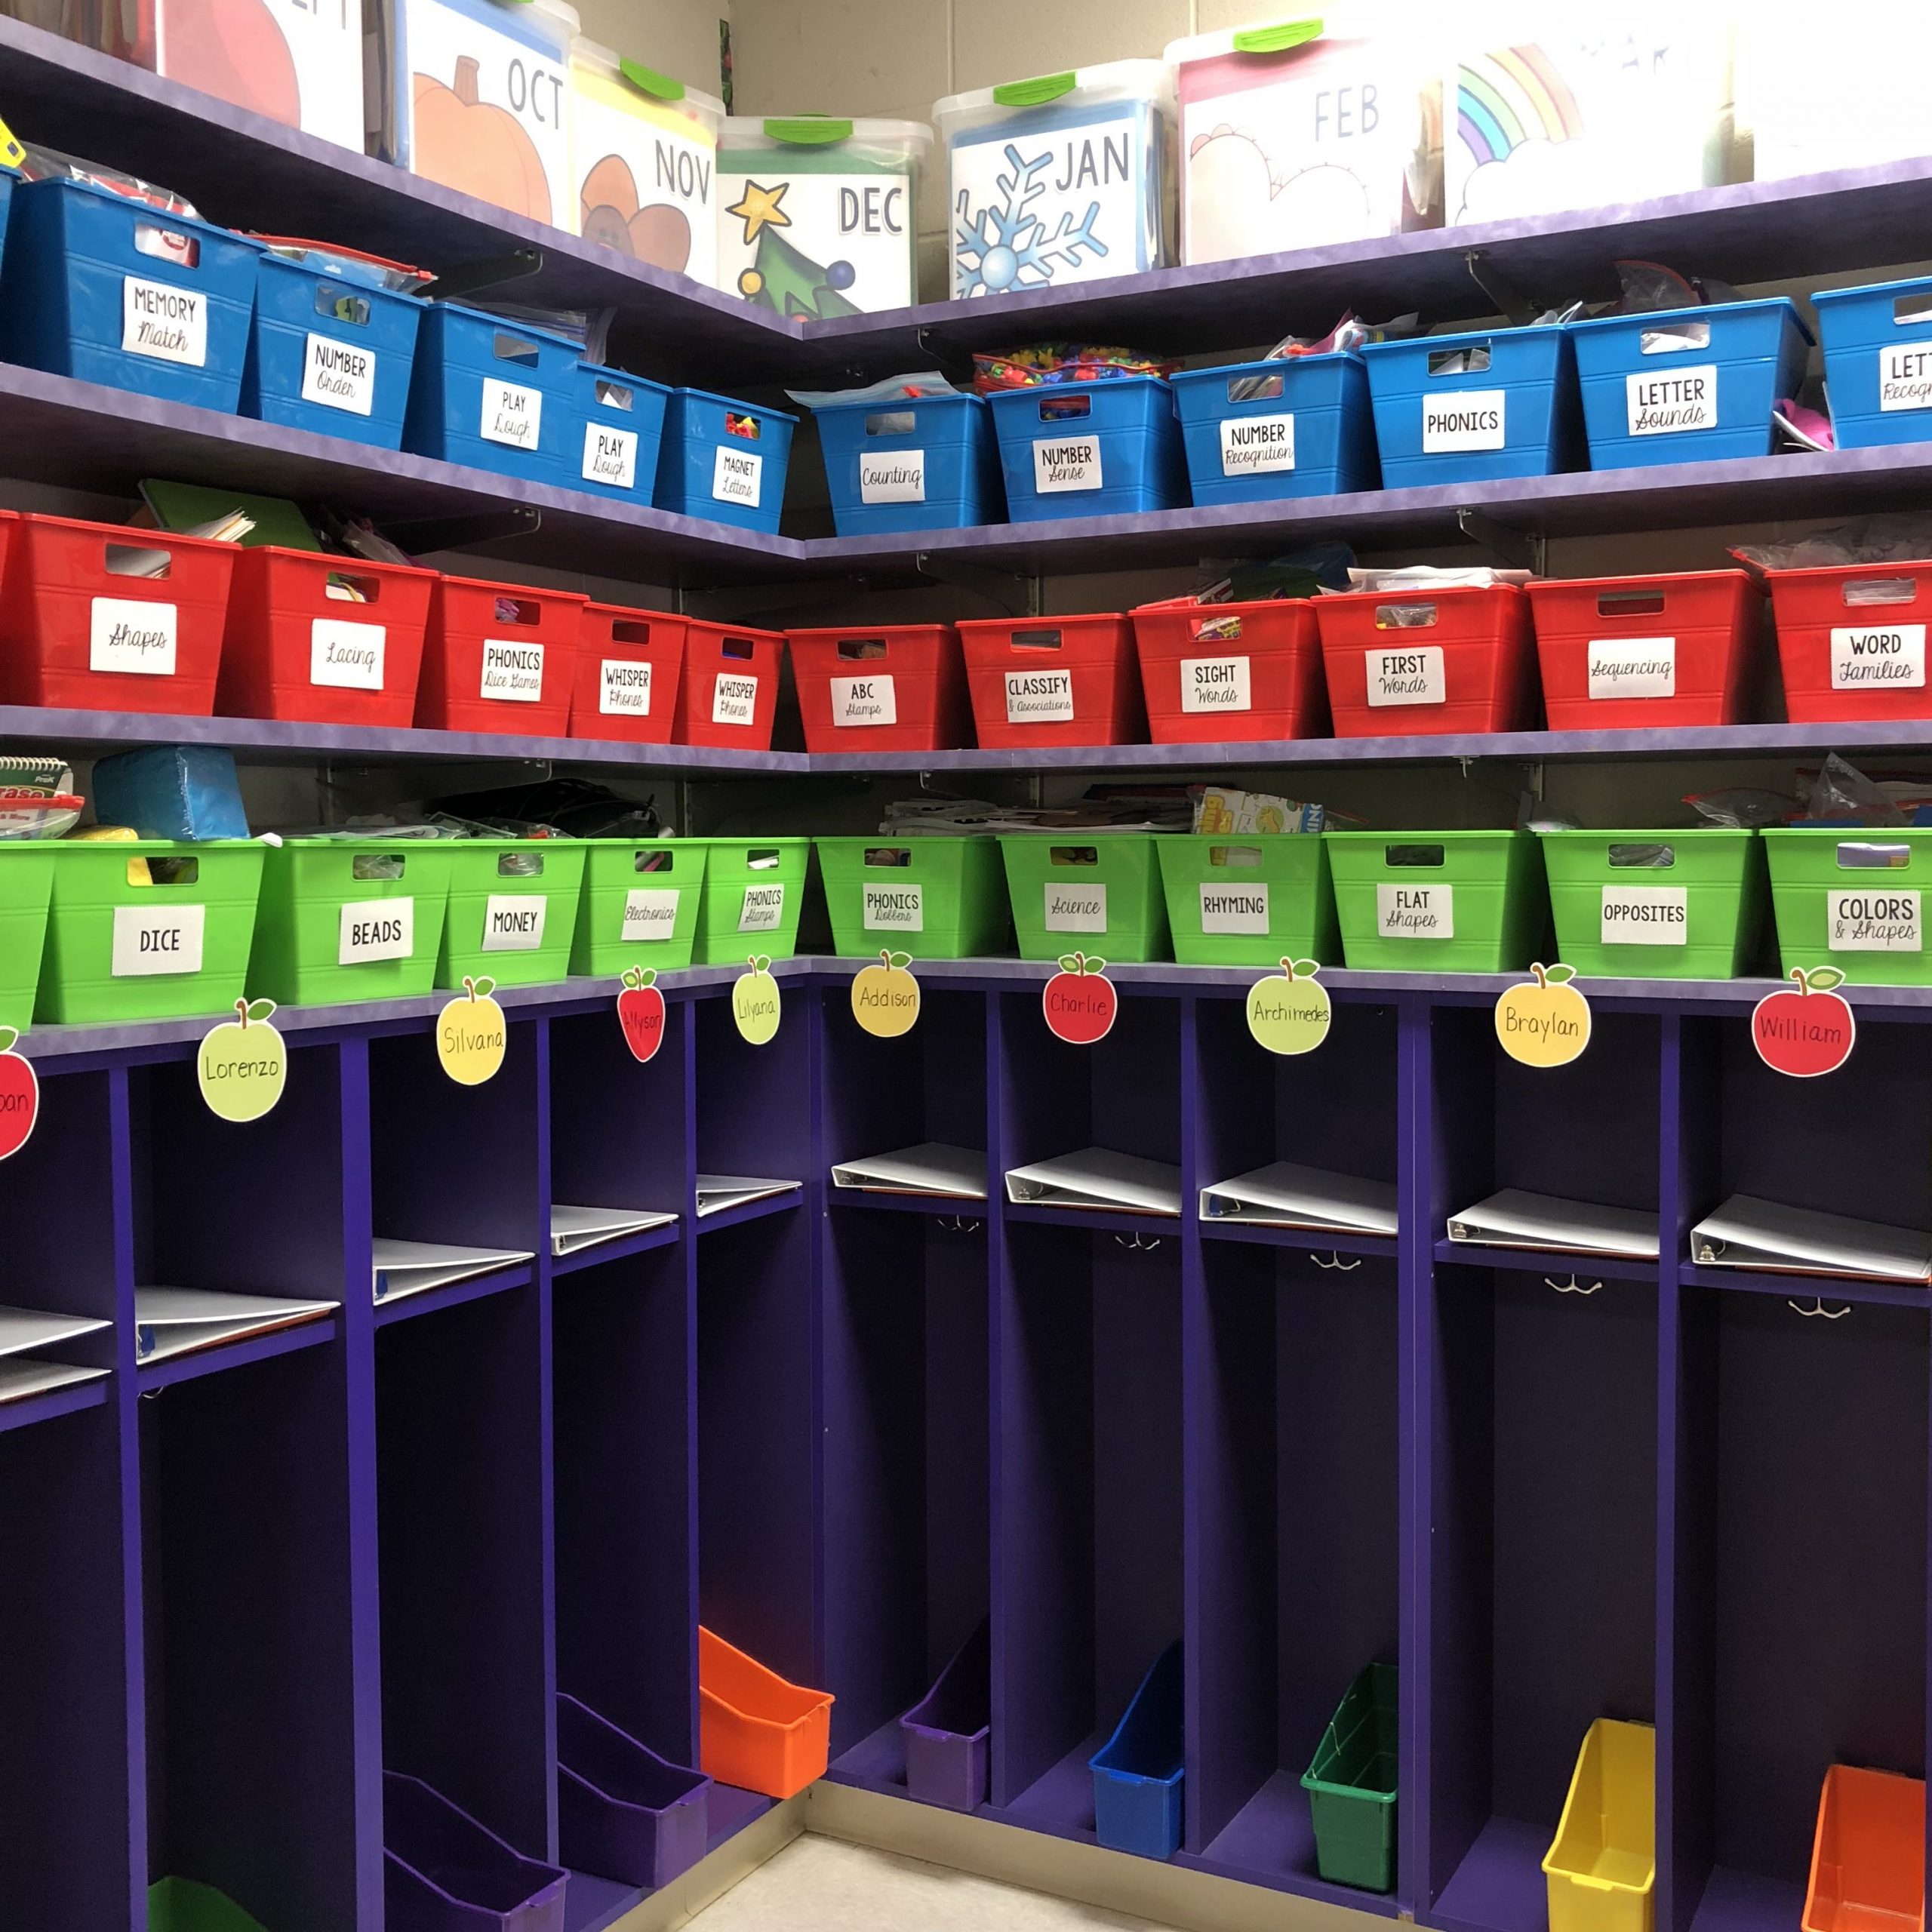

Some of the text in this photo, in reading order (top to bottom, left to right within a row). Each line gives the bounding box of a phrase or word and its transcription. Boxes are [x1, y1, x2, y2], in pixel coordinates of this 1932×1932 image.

[508, 58, 564, 130] OCT
[1315, 85, 1379, 142] FEB
[1055, 131, 1128, 191] JAN
[655, 140, 710, 205] NOV
[841, 187, 902, 232] DEC
[135, 286, 196, 322] MEMORY
[137, 321, 189, 352] Match
[315, 343, 367, 378] NUMBER
[1892, 352, 1932, 379] LET
[317, 371, 356, 398] Order
[1639, 379, 1704, 408] LETTER
[503, 392, 526, 412] PLAY
[494, 412, 531, 444] Dough
[1429, 411, 1497, 433] PHONICS
[1635, 405, 1709, 432] Sounds
[598, 435, 624, 457] PLAY
[1232, 424, 1284, 447] NUMBER
[724, 455, 755, 476] MAGNET
[1042, 446, 1091, 466] NUMBER
[1225, 445, 1294, 466] Recognition
[592, 455, 626, 481] Dough
[863, 466, 922, 490] Counting
[1047, 464, 1084, 482] Sense
[722, 477, 752, 498] Letters
[109, 623, 167, 655] Shapes
[1850, 635, 1901, 655] WORD
[326, 642, 375, 673] Lacing
[488, 649, 541, 670] PHONICS
[1383, 655, 1426, 676] FIRST
[484, 670, 540, 691] Dice Games
[606, 667, 649, 688] WHISPER
[1195, 665, 1235, 683] SIGHT
[1591, 658, 1672, 681] Sequencing
[1840, 661, 1914, 681] Families
[718, 679, 755, 700] WHISPER
[851, 683, 874, 700] ABC
[1008, 676, 1069, 697] CLASSIFY
[1195, 687, 1238, 703] Words
[1379, 675, 1428, 694] Words
[610, 688, 645, 707] Phones
[720, 700, 749, 717] Phones
[1008, 699, 1072, 713] & Associations
[845, 703, 881, 718] Stamps
[746, 889, 783, 906] PHONICS
[867, 894, 918, 909] PHONICS
[1051, 897, 1100, 914] Science
[1203, 897, 1264, 913] RHYMING
[1396, 891, 1429, 909] FLAT
[625, 905, 675, 921] Electronics
[744, 906, 774, 925] Stamps
[1386, 909, 1438, 931] Shapes
[1603, 904, 1685, 923] OPPOSITES
[1838, 899, 1913, 921] COLORS
[352, 920, 401, 946] BEADS
[494, 912, 537, 932] MONEY
[140, 929, 180, 952] DICE
[1835, 922, 1916, 946] & Shapes
[859, 987, 916, 1008] Addison
[1050, 992, 1107, 1017] Charlie
[738, 998, 776, 1023] Lilyana
[1254, 1000, 1330, 1023] Archimedes
[1506, 1008, 1579, 1044] Braylan
[1760, 1015, 1841, 1045] William
[445, 1027, 504, 1054] Silvana
[206, 1056, 278, 1081] Lorenzo
